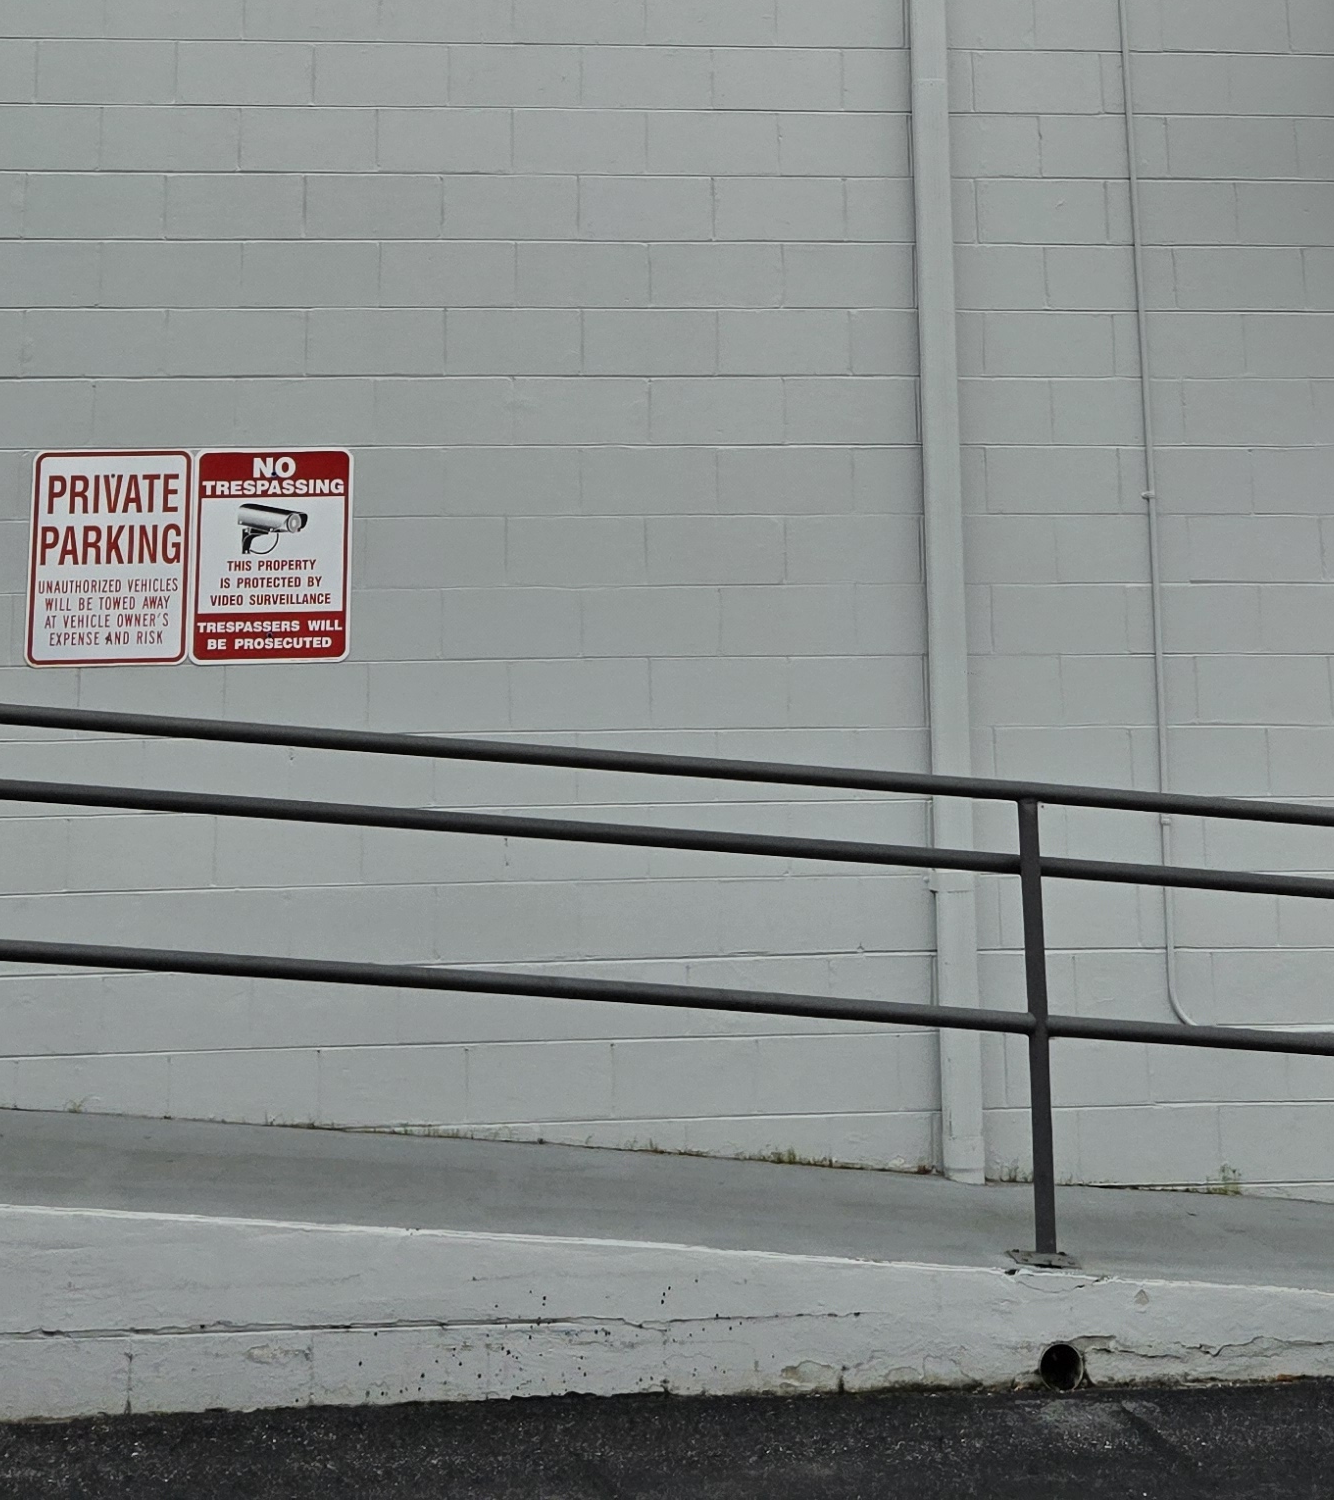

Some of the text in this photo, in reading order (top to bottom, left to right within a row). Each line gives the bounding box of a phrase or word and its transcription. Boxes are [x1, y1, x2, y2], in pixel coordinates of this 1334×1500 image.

[253, 457, 296, 478] NO
[47, 473, 180, 514] PRIVATE
[202, 479, 345, 496] TRESPASSING
[40, 524, 181, 565] PARKING
[227, 560, 317, 572] THIS PROPERTY
[39, 578, 178, 594] UNAUTHORIZED VEHICLES
[220, 576, 322, 589] IS PROTECTED BY
[45, 596, 171, 612] WILL BE TOWED AWAY
[210, 594, 331, 606] VIDEO SURVEILLANCE
[45, 613, 169, 629] AT VEHICLE OWNER'S
[197, 619, 342, 633] TRESPASSERS WILL
[49, 631, 163, 646] EXPENSE AND RISK
[207, 636, 332, 650] BE PROSECUTED
